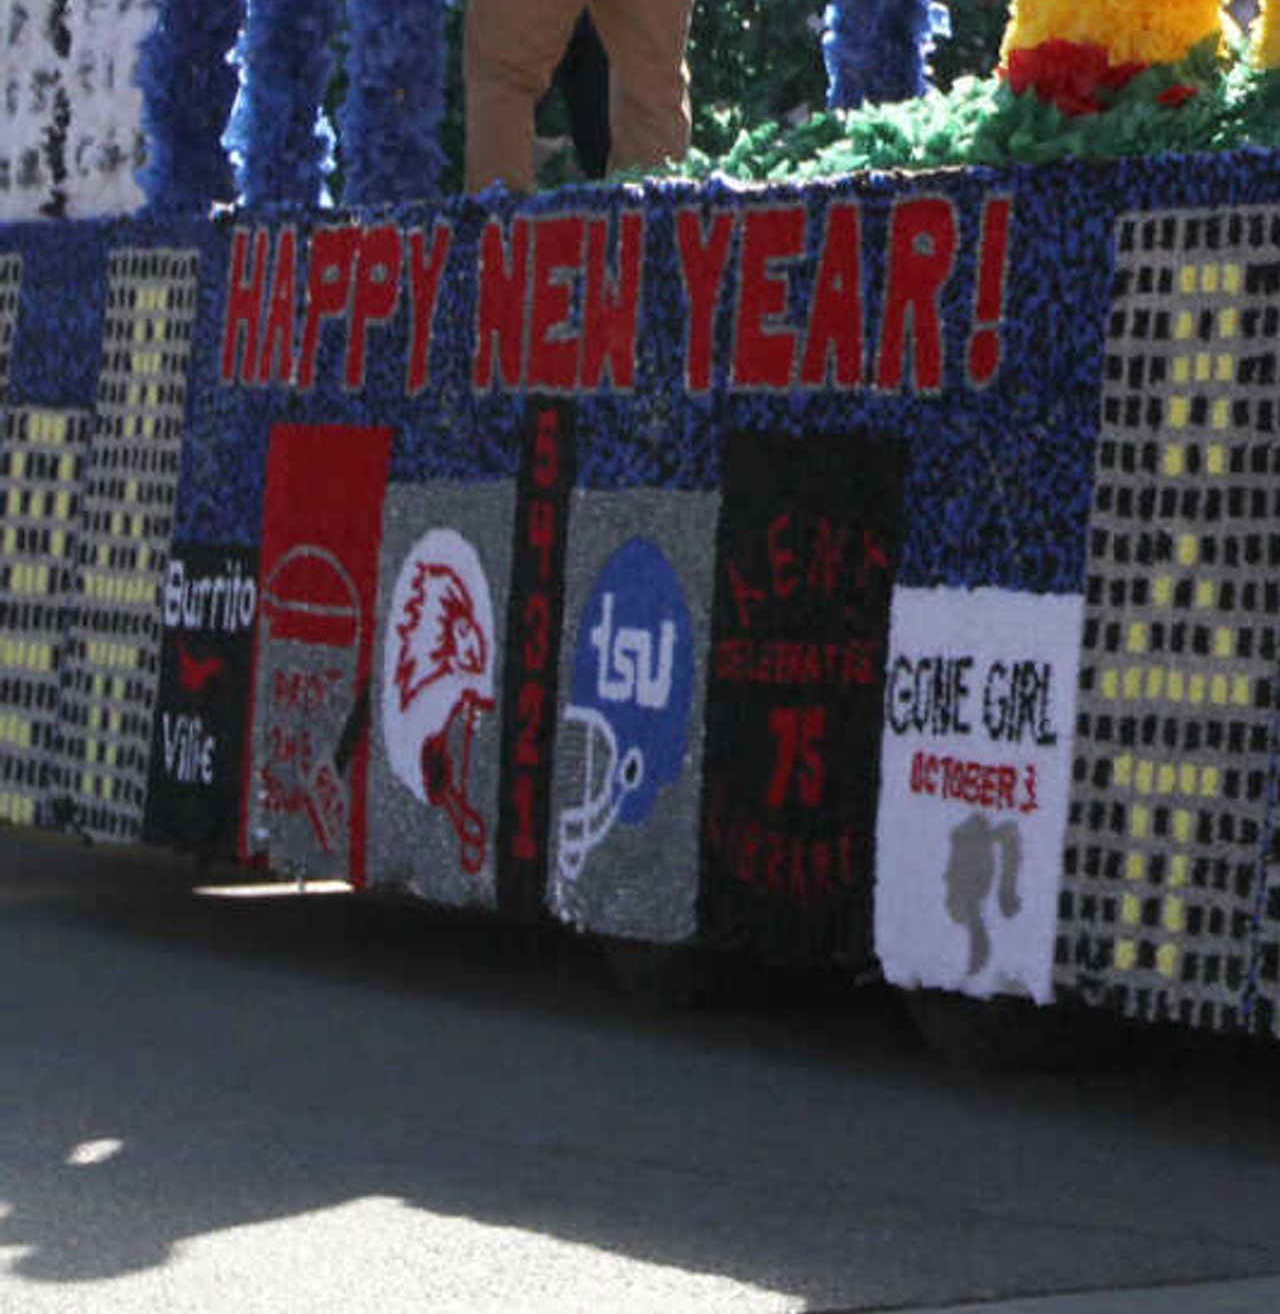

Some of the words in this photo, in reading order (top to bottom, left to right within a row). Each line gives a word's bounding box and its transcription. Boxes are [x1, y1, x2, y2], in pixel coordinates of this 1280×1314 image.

[220, 220, 452, 392] HAPPY
[473, 210, 648, 394] NEW
[674, 193, 1013, 397] YEAR!
[163, 558, 257, 631] Burrito
[883, 653, 973, 737] GONE
[982, 658, 1057, 746] GIRL
[767, 706, 828, 809] 75
[909, 749, 1017, 813] OCTOBER
